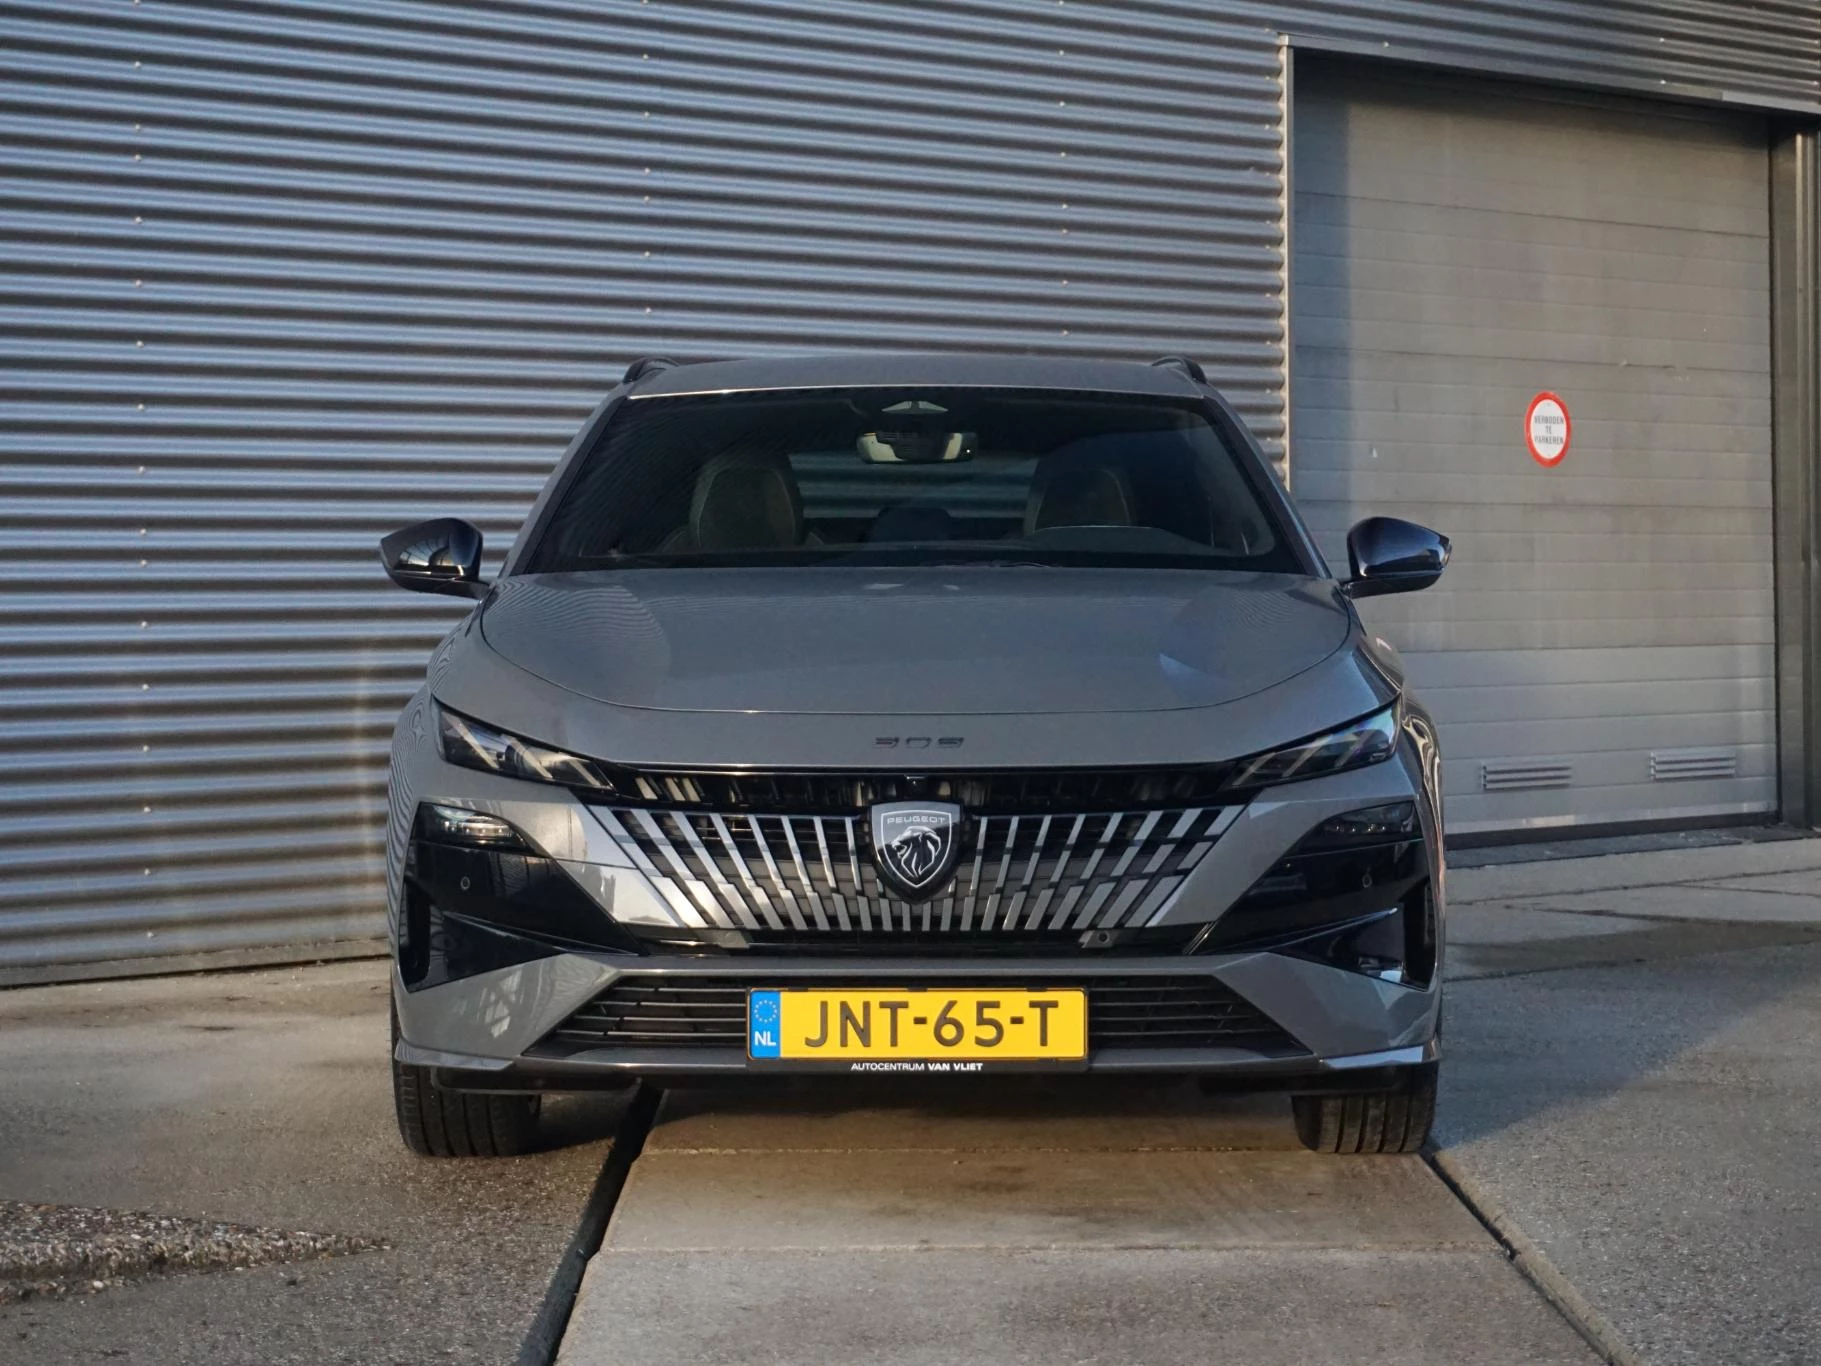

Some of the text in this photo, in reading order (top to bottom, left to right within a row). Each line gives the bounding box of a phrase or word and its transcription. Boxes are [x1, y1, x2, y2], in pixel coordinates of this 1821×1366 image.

[1545, 425, 1552, 434] TE
[887, 815, 946, 825] PEUGEOT
[804, 1000, 1059, 1048] JNT-65-T
[754, 1031, 777, 1046] NL
[850, 1062, 984, 1072] AUTOCENTRUM VAN VLIET
